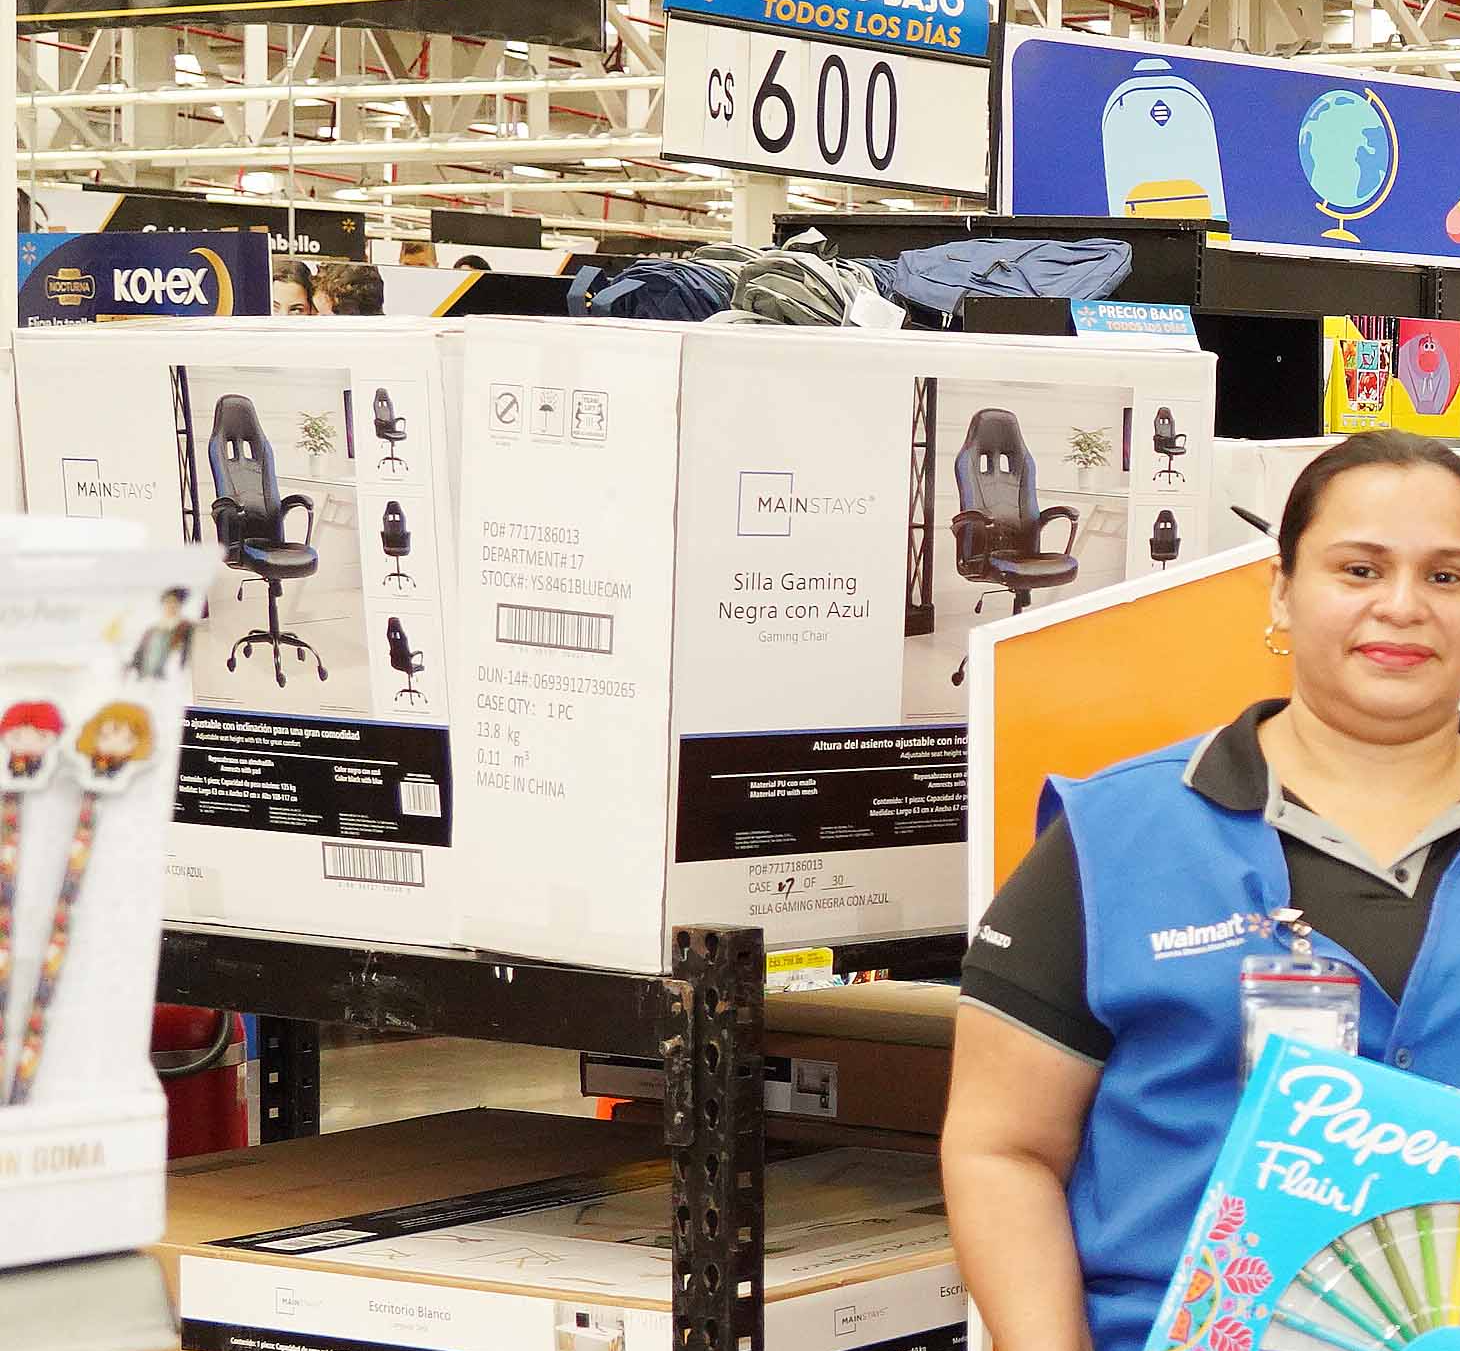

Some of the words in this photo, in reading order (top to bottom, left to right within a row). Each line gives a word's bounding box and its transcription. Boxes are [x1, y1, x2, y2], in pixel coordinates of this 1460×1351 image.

[856, 8, 911, 36] LOS
[917, 11, 961, 49] DÍAS
[707, 65, 736, 123] C$
[752, 49, 897, 172] 600
[1098, 305, 1148, 319] PRECIO
[1151, 308, 1184, 320] BAJO
[77, 482, 153, 500] MAINSTAYS
[758, 497, 868, 514] MAINSTAYS
[483, 521, 506, 538] PO#
[509, 523, 580, 545] 7717186013
[482, 546, 568, 568] DEPARTMENT#
[571, 554, 584, 571] 17
[734, 572, 773, 590] Silla
[782, 572, 857, 595] Gaming
[719, 602, 777, 624] Negra
[785, 605, 819, 618] con
[827, 599, 870, 618] Azul
[759, 631, 798, 643] Gaming
[477, 694, 504, 711] CASE
[508, 699, 535, 715] QTY:
[558, 705, 574, 720] PC
[813, 739, 841, 751] Altura
[844, 738, 858, 749] del
[861, 738, 893, 749] asiento
[896, 736, 934, 748] ajustable
[477, 770, 510, 791] MADE
[513, 776, 525, 792] IN
[529, 778, 565, 798] CHINA
[750, 902, 772, 916] SILLA
[775, 898, 813, 914] GAMING
[815, 896, 844, 910] NEGRA
[846, 895, 865, 908] CON
[867, 892, 889, 905] AZUL
[1151, 912, 1244, 950] Walmart
[368, 1300, 414, 1319] Escritorio
[418, 1305, 451, 1323] Blanco
